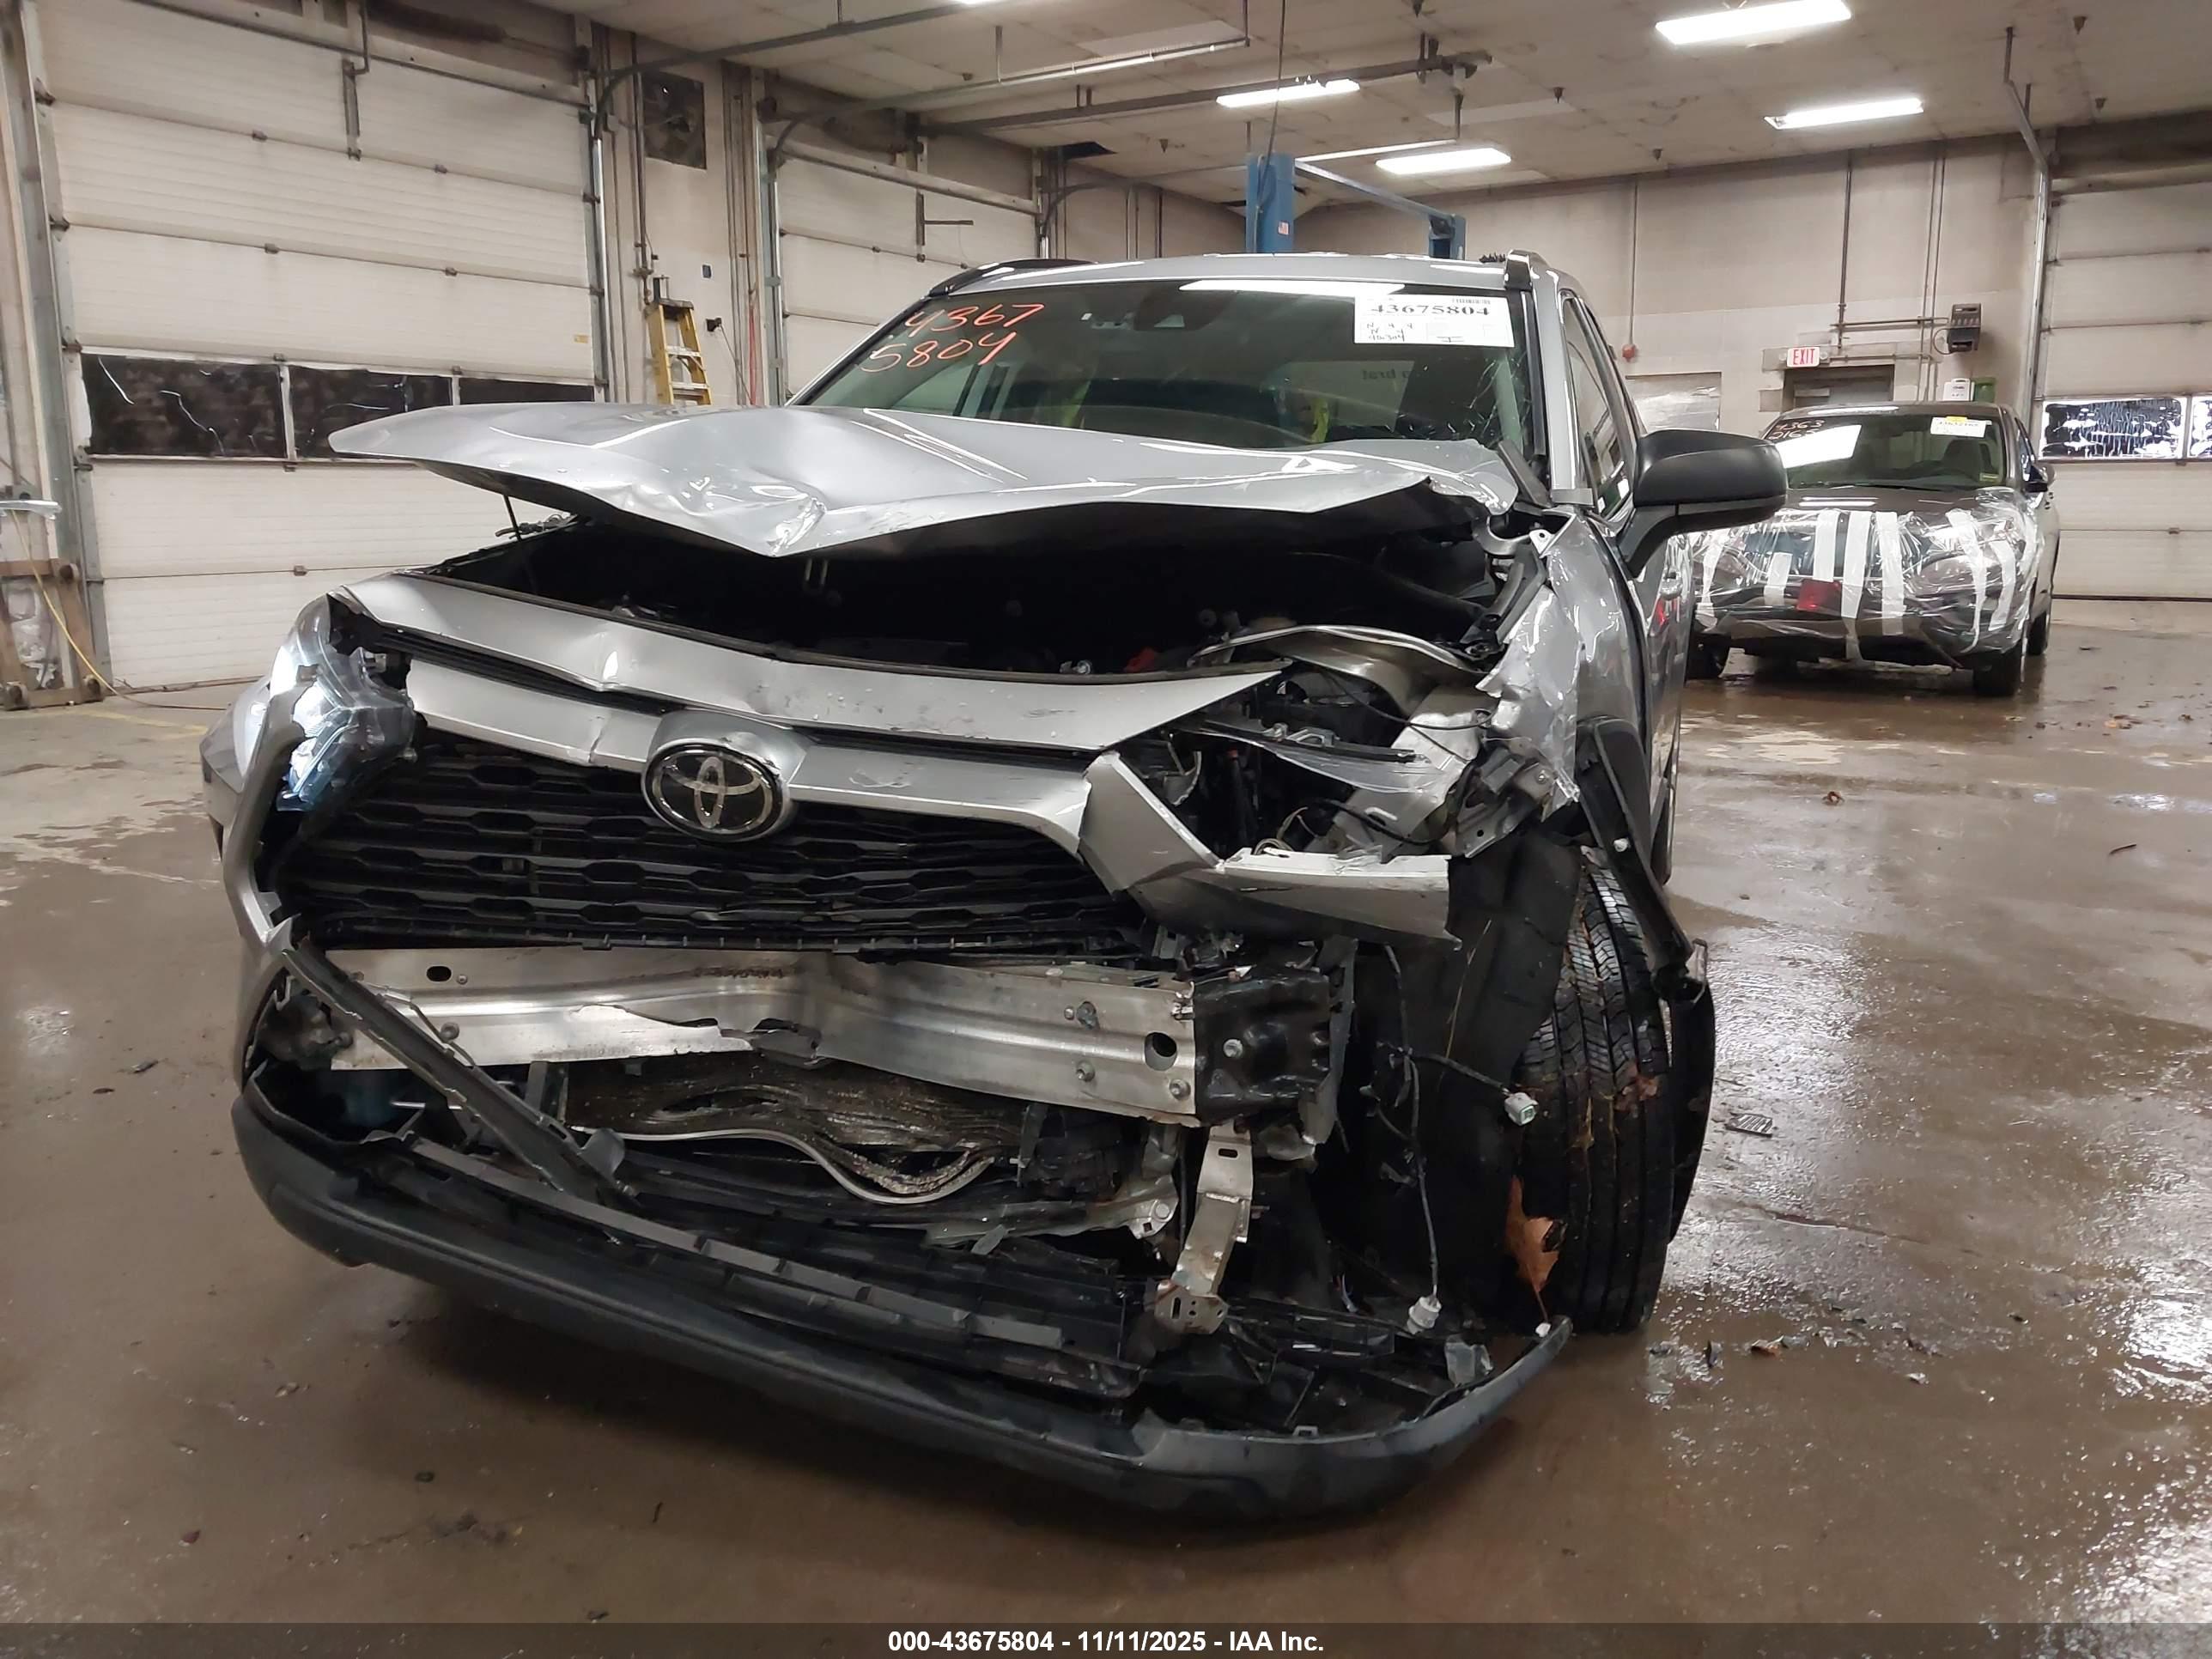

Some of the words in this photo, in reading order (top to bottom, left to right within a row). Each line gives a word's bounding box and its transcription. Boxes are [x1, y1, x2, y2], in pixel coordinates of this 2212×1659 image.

[904, 303, 1045, 337] 4367
[1370, 304, 1490, 316] 43675804
[860, 331, 1017, 373] 5804
[1792, 348, 1815, 365] EXIT
